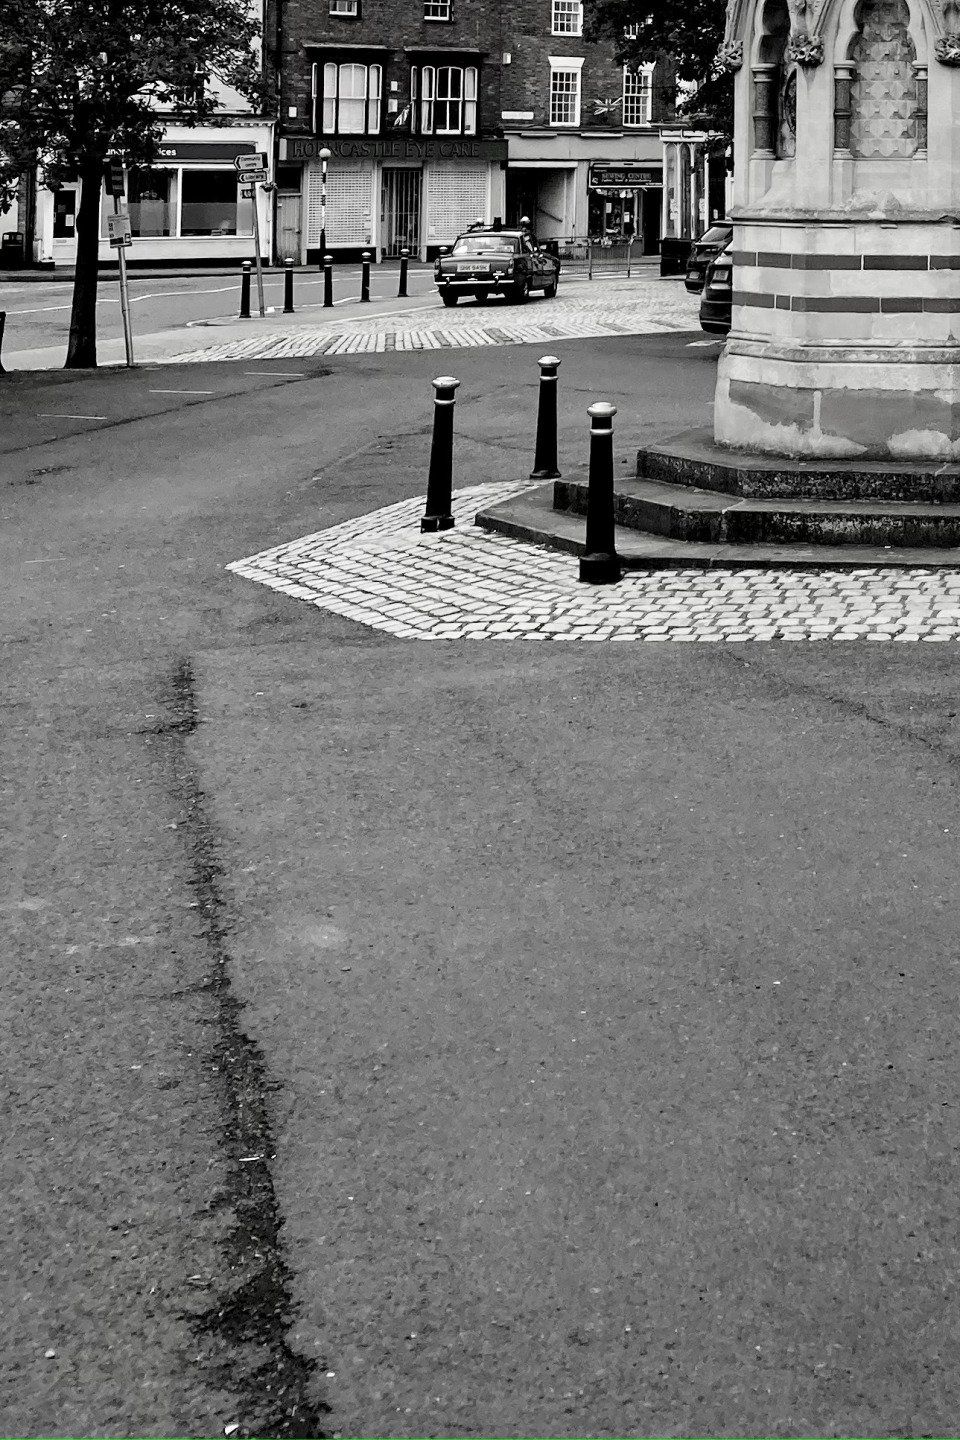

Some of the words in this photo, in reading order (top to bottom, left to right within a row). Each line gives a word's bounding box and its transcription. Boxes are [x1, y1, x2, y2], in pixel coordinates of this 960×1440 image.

[293, 142, 400, 158] HORNCASTLE
[404, 142, 434, 158] EYE
[439, 142, 480, 158] CARE
